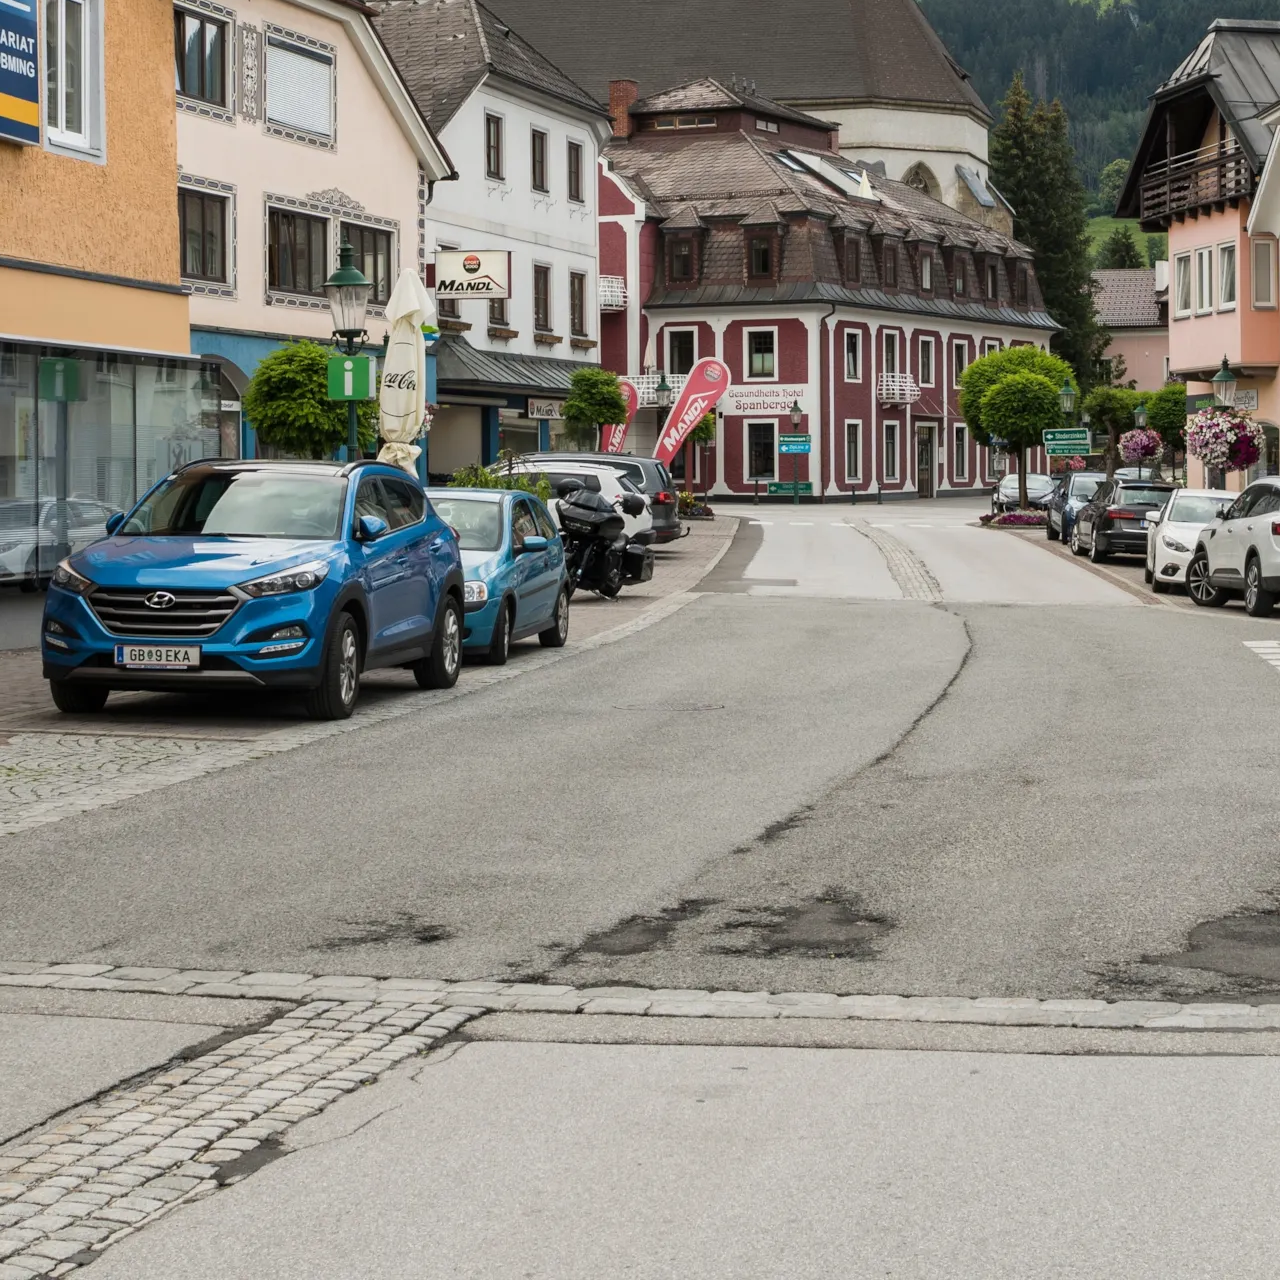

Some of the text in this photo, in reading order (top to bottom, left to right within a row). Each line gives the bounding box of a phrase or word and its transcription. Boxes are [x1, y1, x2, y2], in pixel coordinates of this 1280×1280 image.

[437, 279, 493, 292] MANDL
[728, 389, 780, 398] Gesundheits
[735, 400, 797, 412] Spanberge
[662, 397, 709, 453] MANDL
[606, 422, 627, 453] ANDL
[129, 648, 146, 662] GB
[165, 649, 192, 663] EKA
